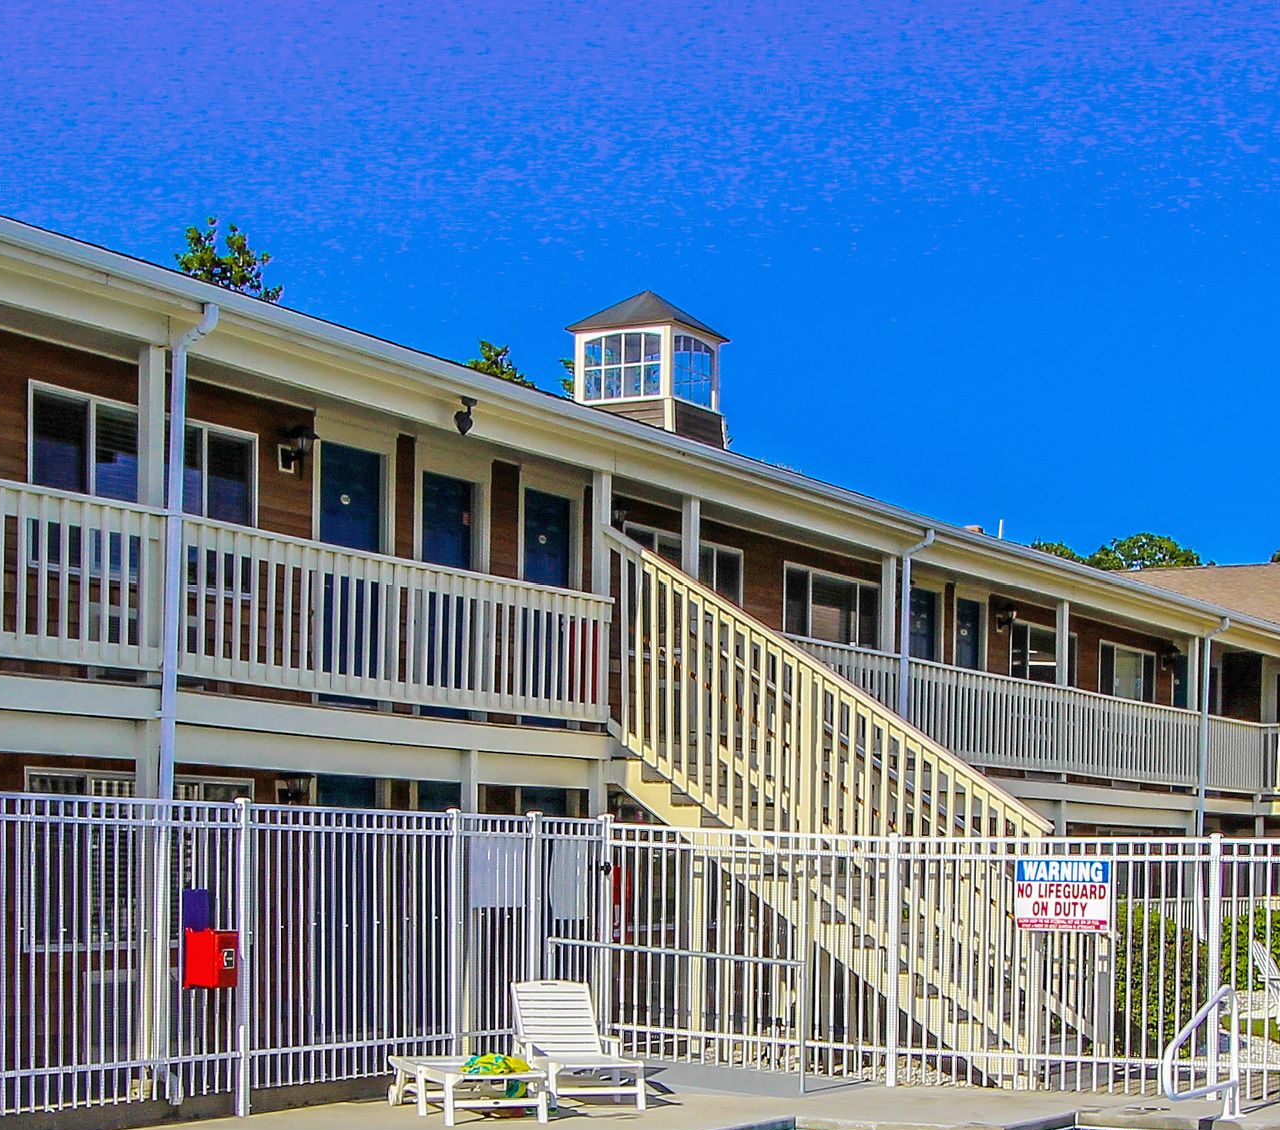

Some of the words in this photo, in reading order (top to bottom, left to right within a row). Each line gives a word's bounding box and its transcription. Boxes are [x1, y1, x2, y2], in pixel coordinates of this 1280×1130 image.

[1023, 861, 1103, 882] WARNING
[1018, 883, 1033, 898] NO
[1038, 883, 1107, 900] LIFEGUARD
[1032, 901, 1048, 916] ON
[1054, 902, 1088, 917] DUTY
